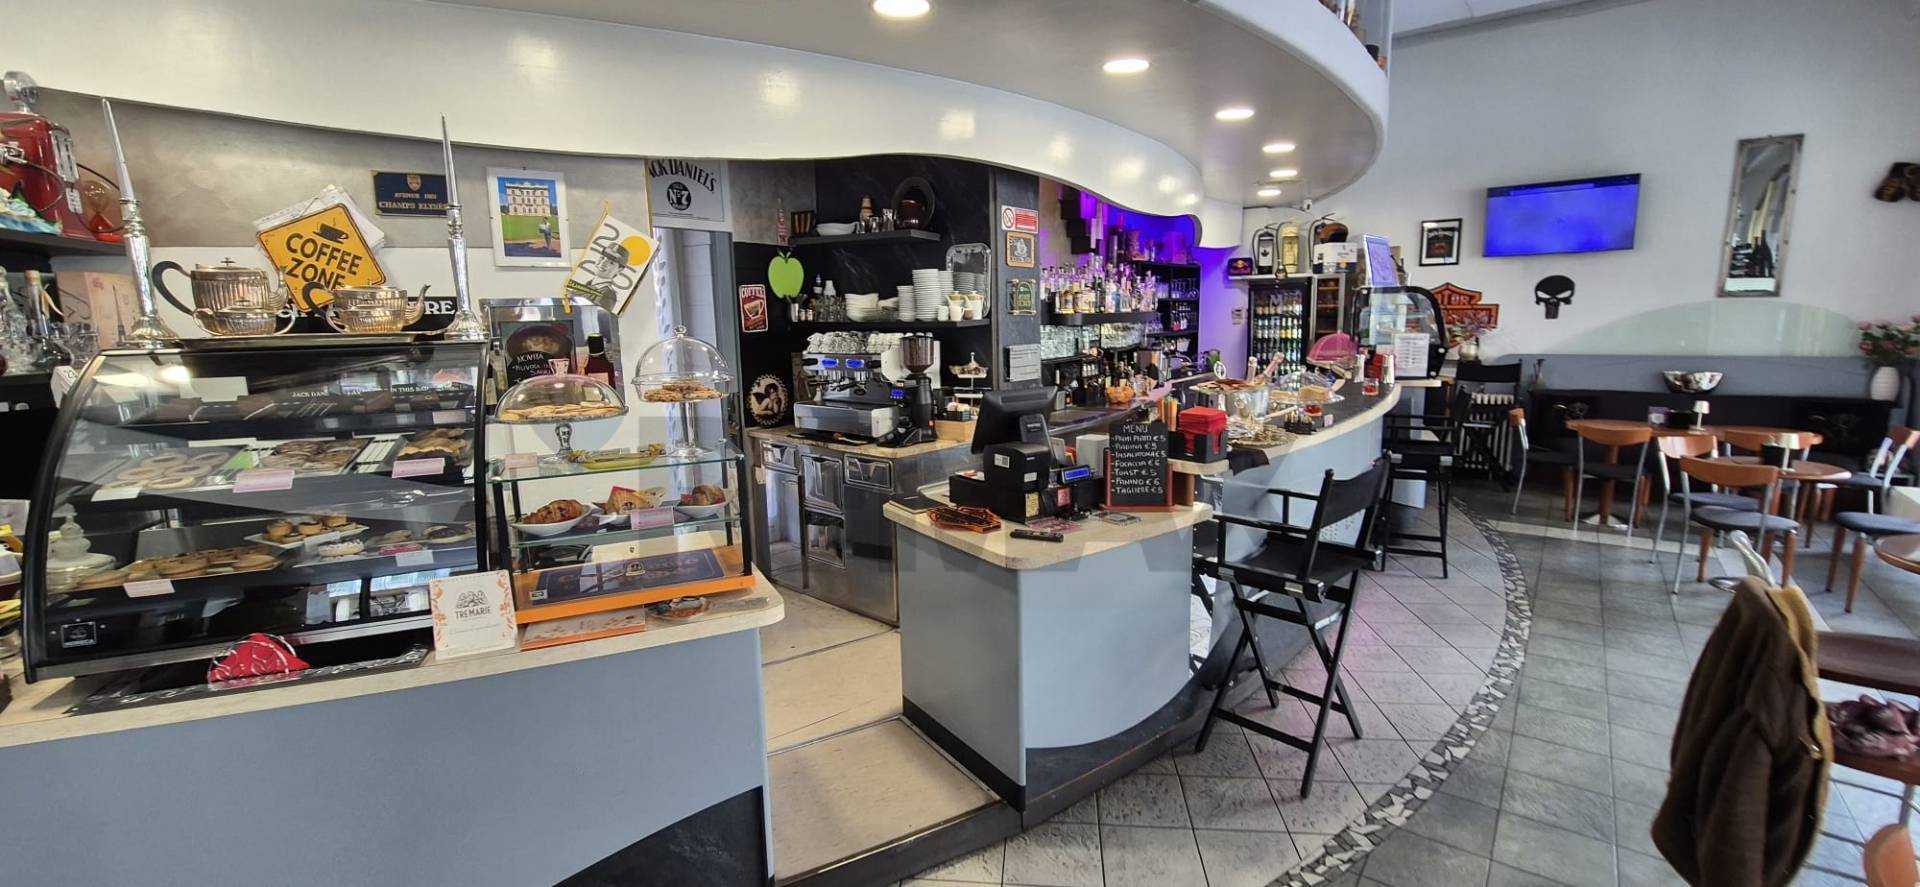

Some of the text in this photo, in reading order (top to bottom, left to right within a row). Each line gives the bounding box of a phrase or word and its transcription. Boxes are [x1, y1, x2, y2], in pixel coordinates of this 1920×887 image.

[378, 201, 416, 209] CHAMPS
[285, 232, 363, 276] COFFEE
[285, 257, 346, 292] ZONE
[741, 287, 765, 299] COFFEE
[1122, 424, 1148, 433] MENU
